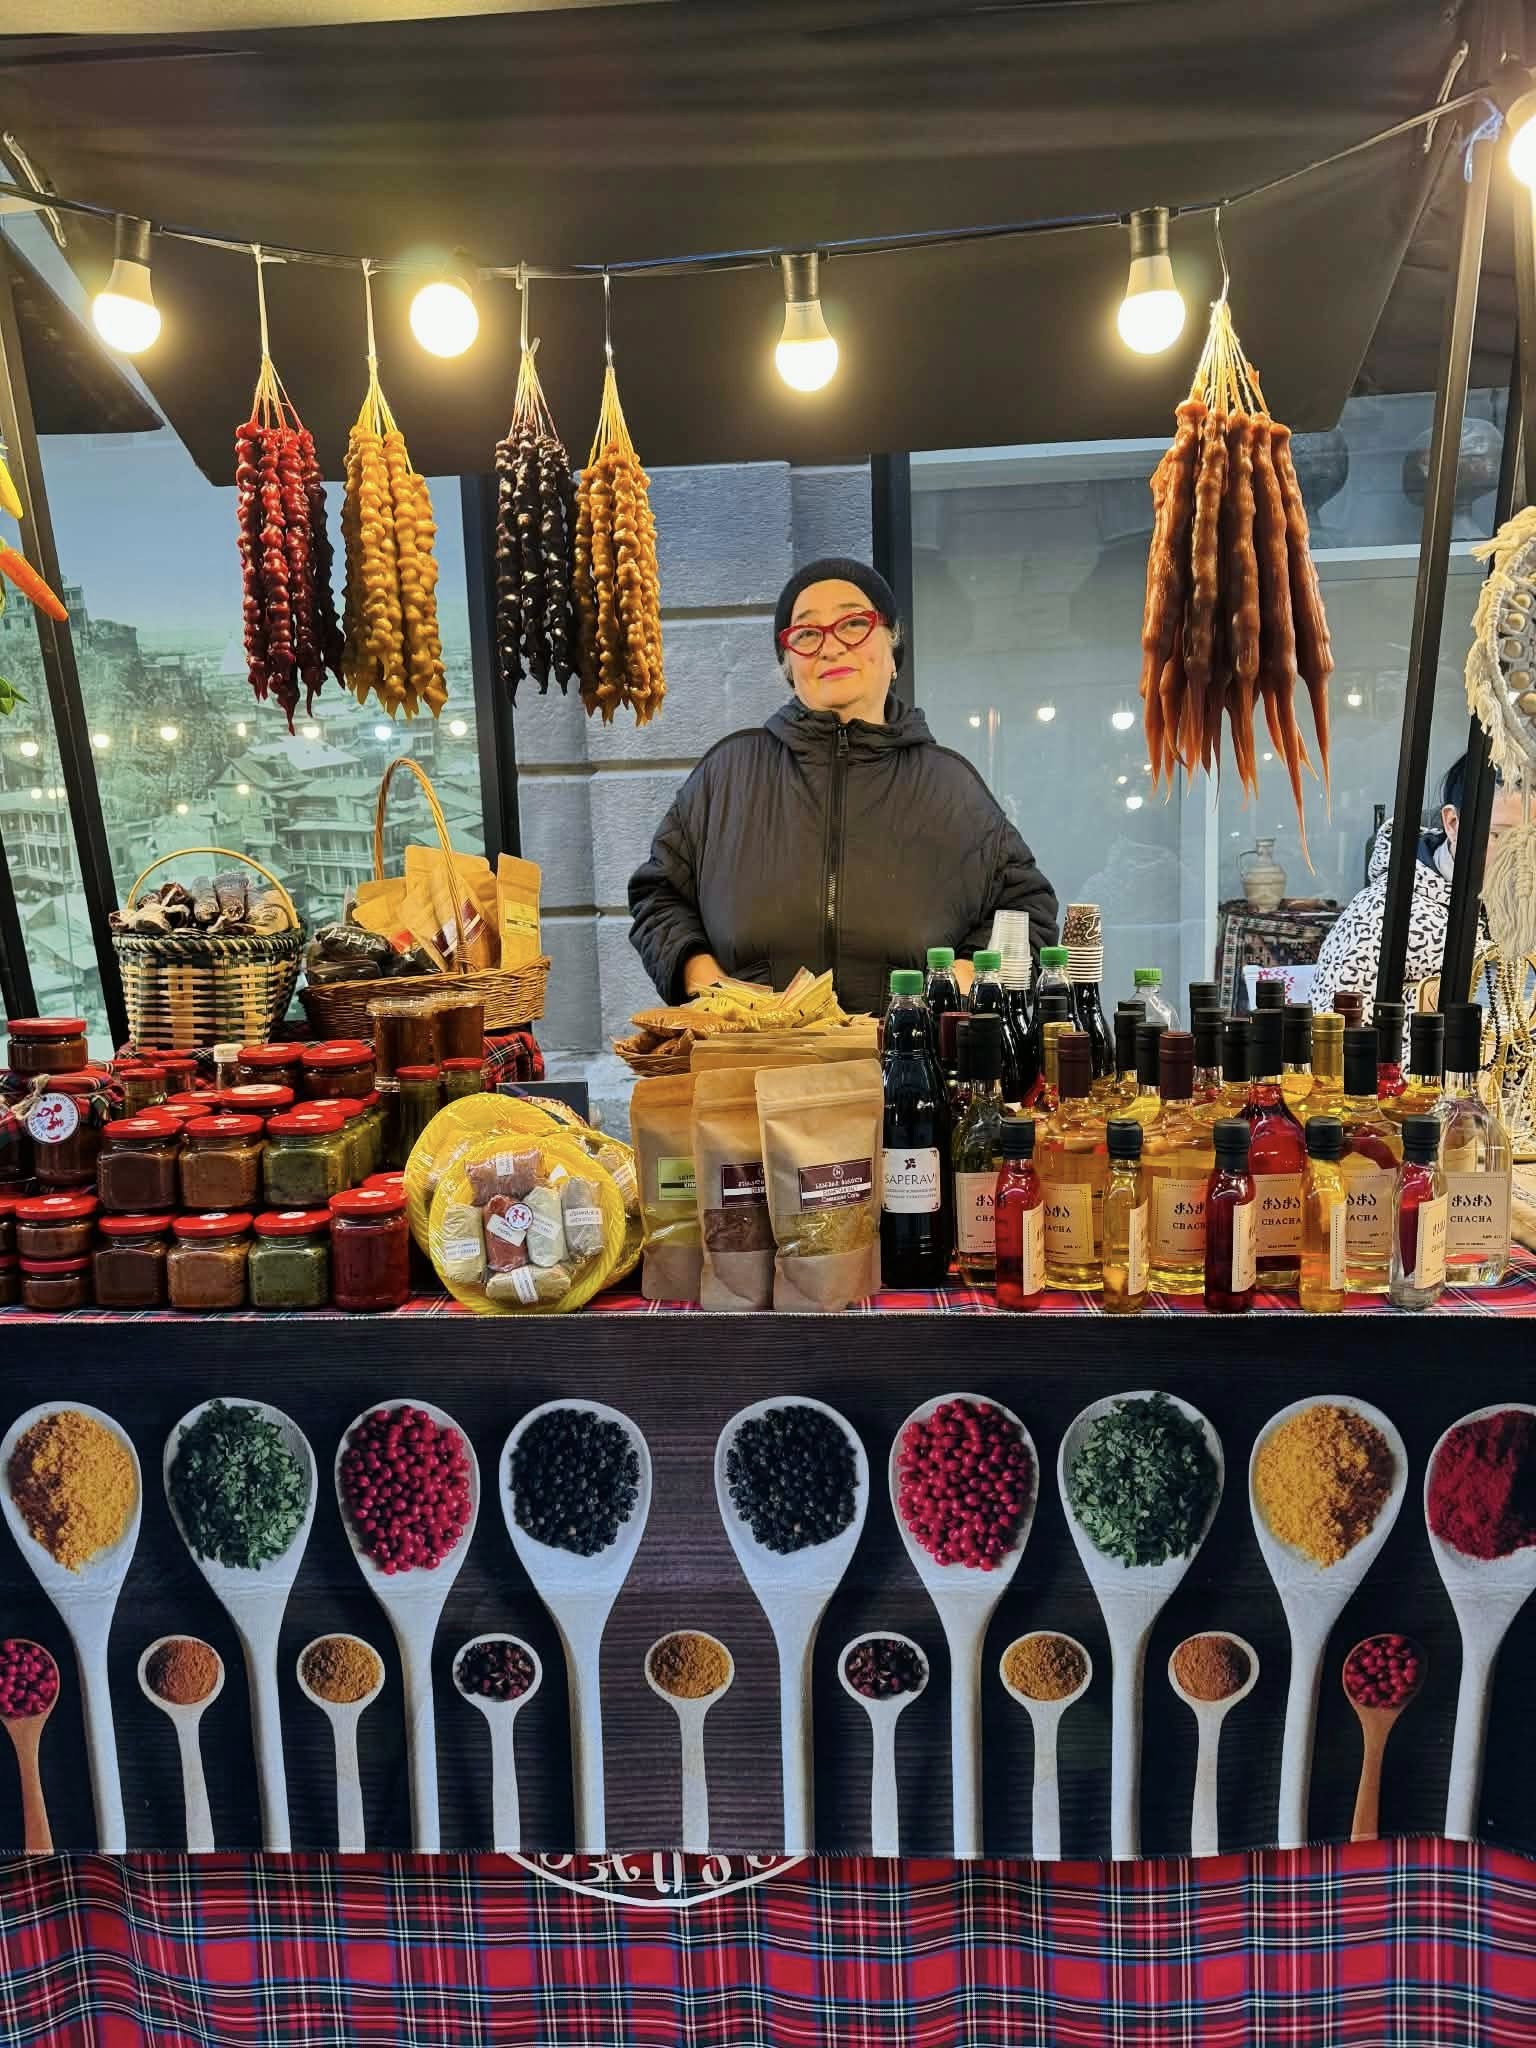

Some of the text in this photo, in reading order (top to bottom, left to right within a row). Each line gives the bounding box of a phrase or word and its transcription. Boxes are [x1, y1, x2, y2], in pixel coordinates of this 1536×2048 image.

[885, 1173, 936, 1185] SAPERAV
[976, 1194, 995, 1207] ჭა
[1346, 1193, 1377, 1207] აჭა
[1451, 1193, 1493, 1208] ჭაჭა
[1045, 1205, 1071, 1217] აჭა
[1174, 1202, 1205, 1215] ჭაჭ
[1261, 1217, 1302, 1225] CHACHA
[1346, 1214, 1378, 1222] ACHA
[1449, 1215, 1493, 1223] CHACHA
[1045, 1224, 1072, 1233] ACHA
[1172, 1222, 1206, 1230] CHACH
